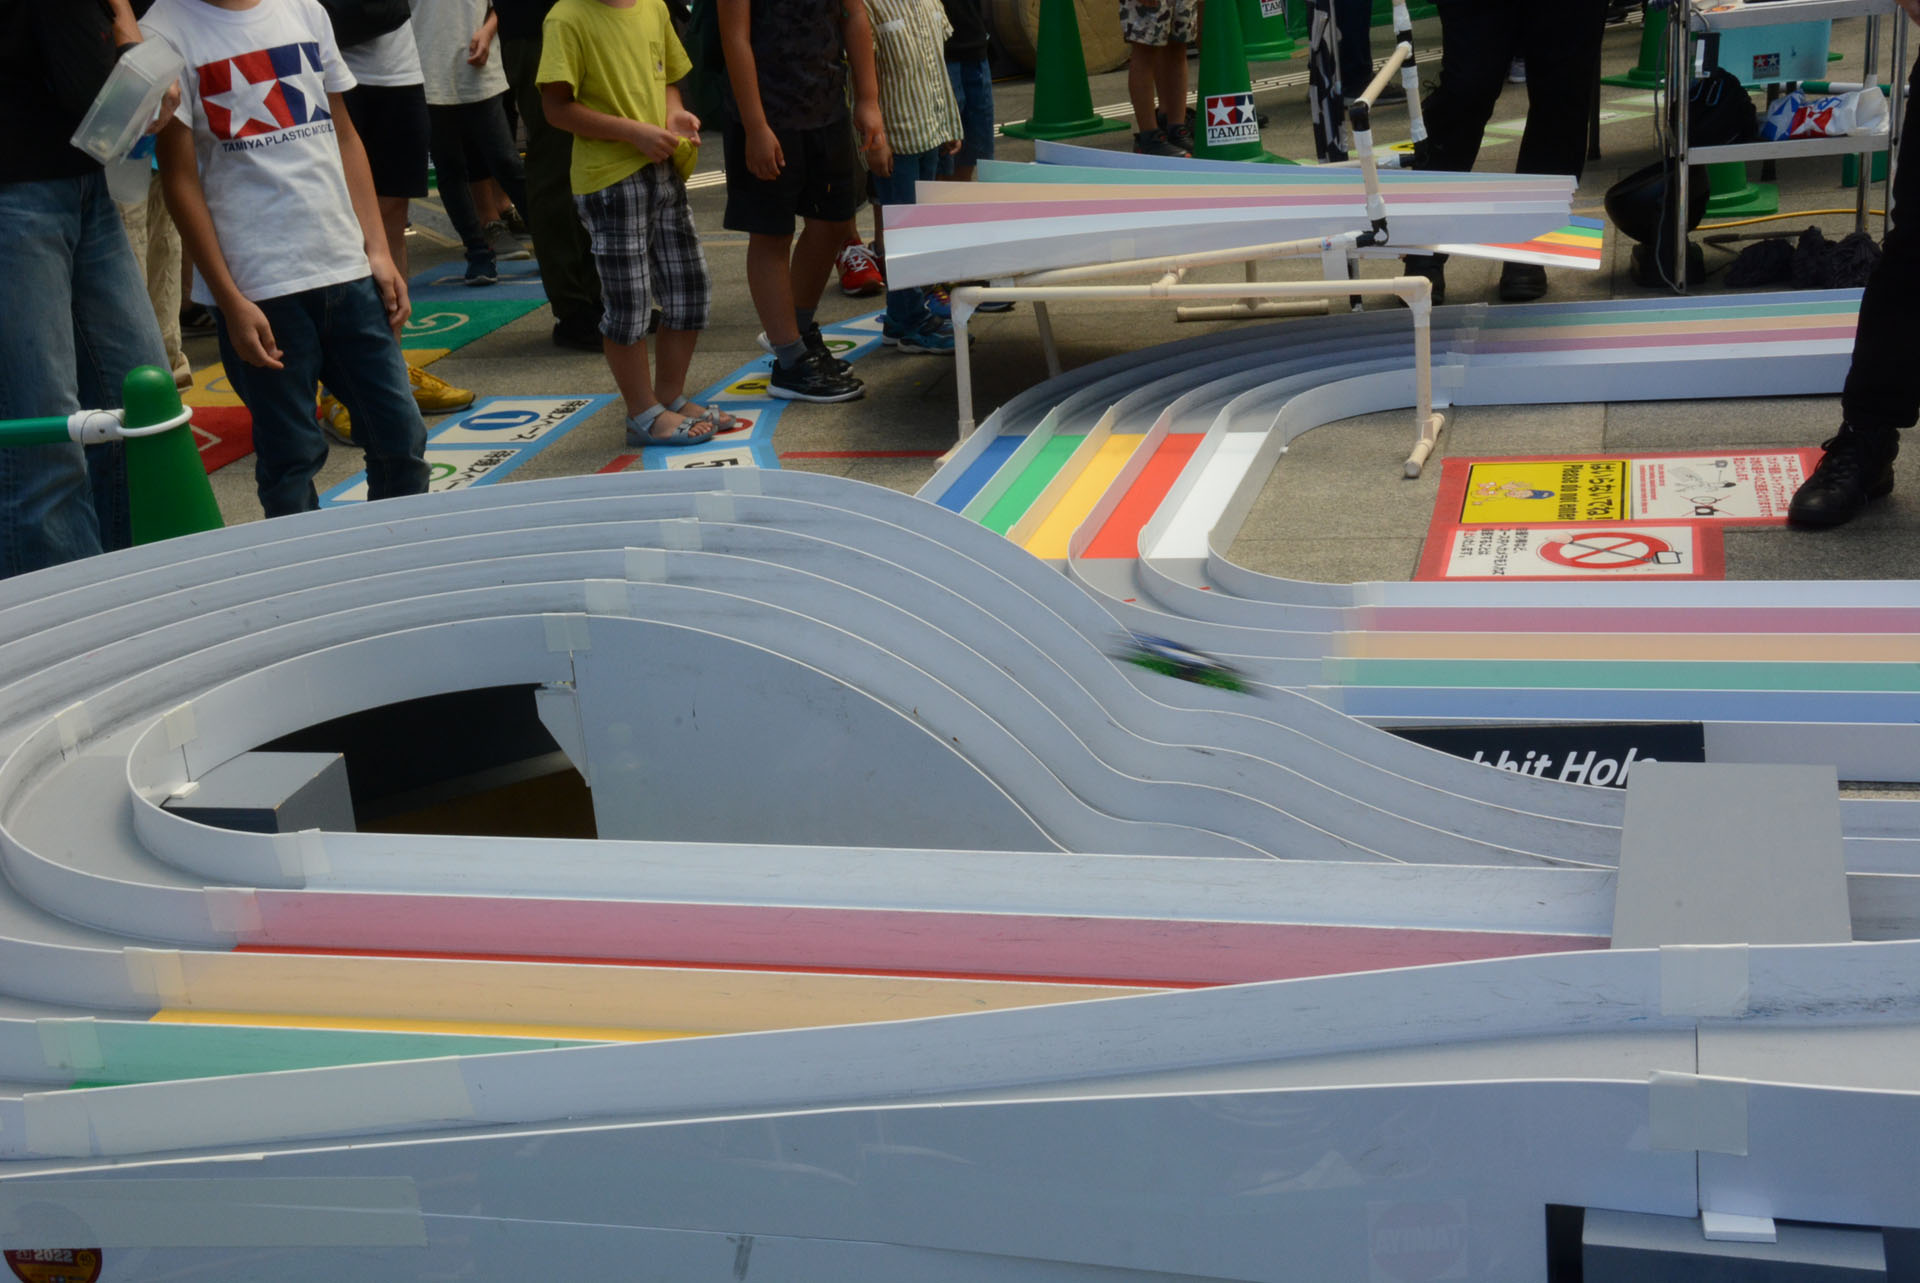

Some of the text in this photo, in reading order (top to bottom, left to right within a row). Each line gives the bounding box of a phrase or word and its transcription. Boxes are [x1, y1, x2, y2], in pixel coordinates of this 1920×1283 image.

[222, 139, 265, 153] TAMIYA
[266, 127, 311, 146] PLASTIC
[1208, 124, 1258, 139] TAMIYA
[1556, 464, 1584, 520] Please do not enter
[1558, 747, 1658, 786] Hol
